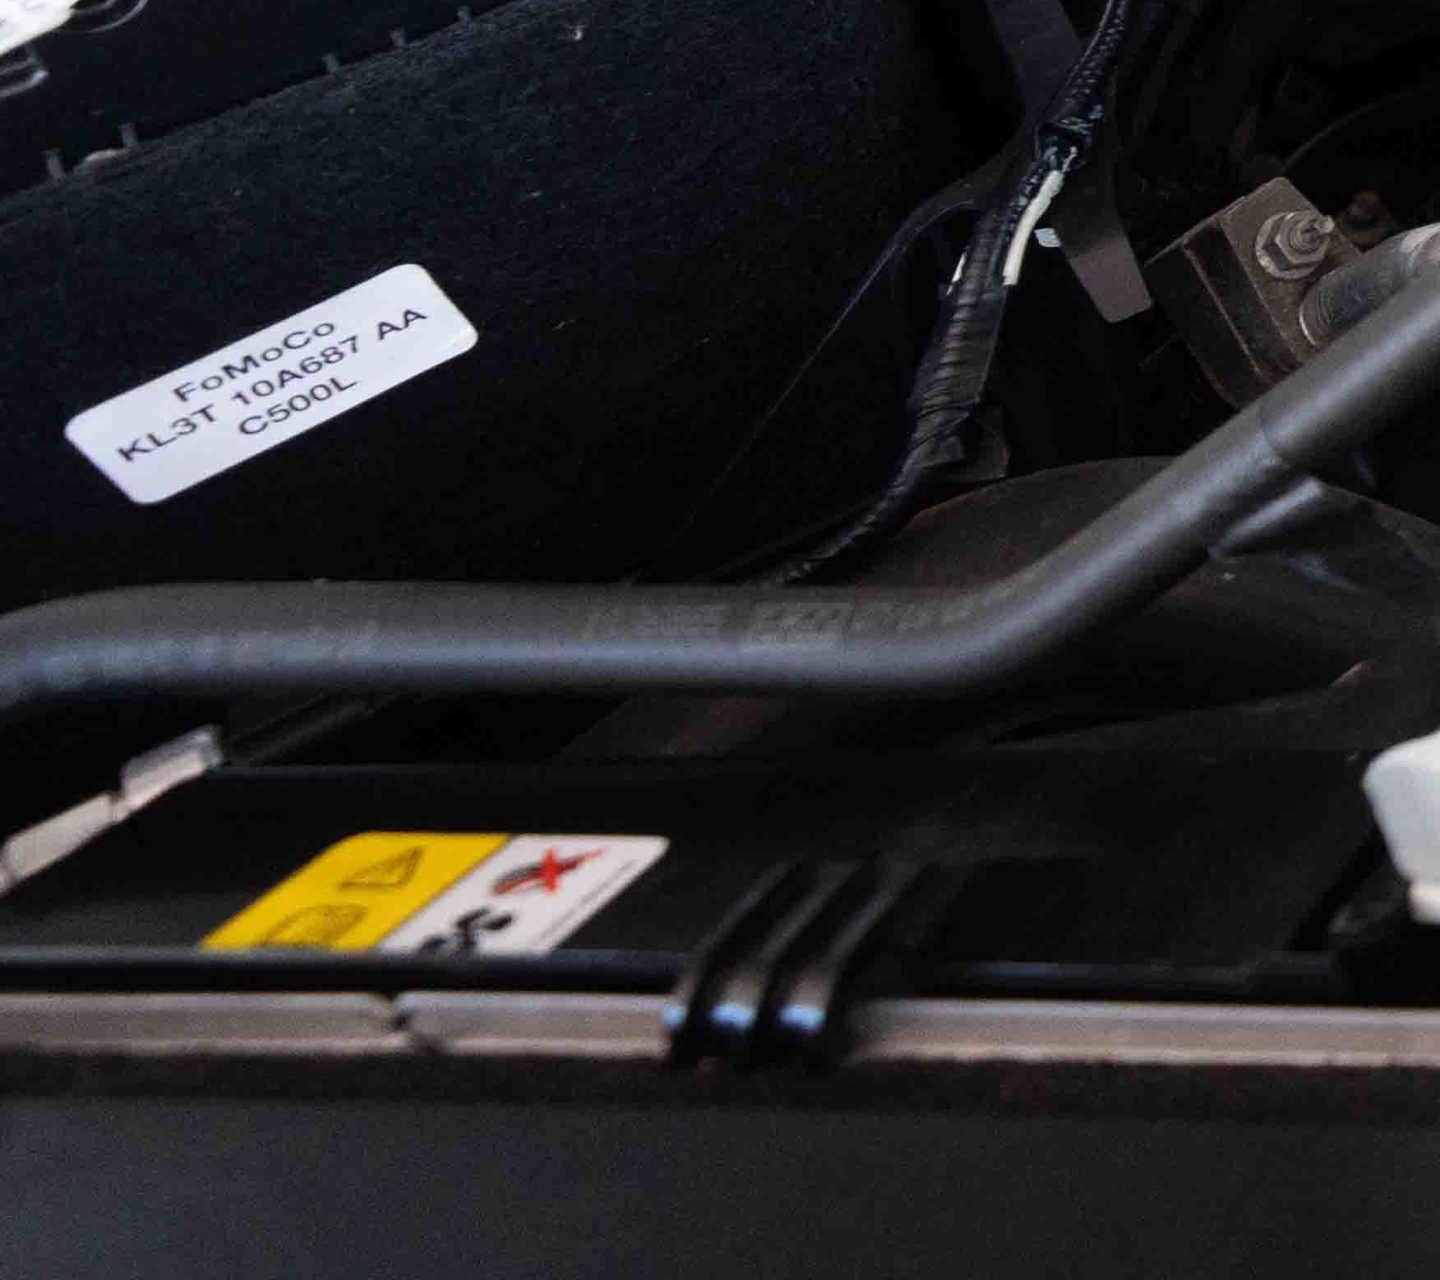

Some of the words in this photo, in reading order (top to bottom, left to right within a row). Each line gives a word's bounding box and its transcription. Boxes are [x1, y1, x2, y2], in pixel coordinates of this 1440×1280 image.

[117, 403, 217, 462] KL3T
[230, 334, 360, 407] 10A687
[374, 307, 428, 341] AA
[173, 321, 336, 402] FoMoCo
[238, 375, 358, 436] C500L
